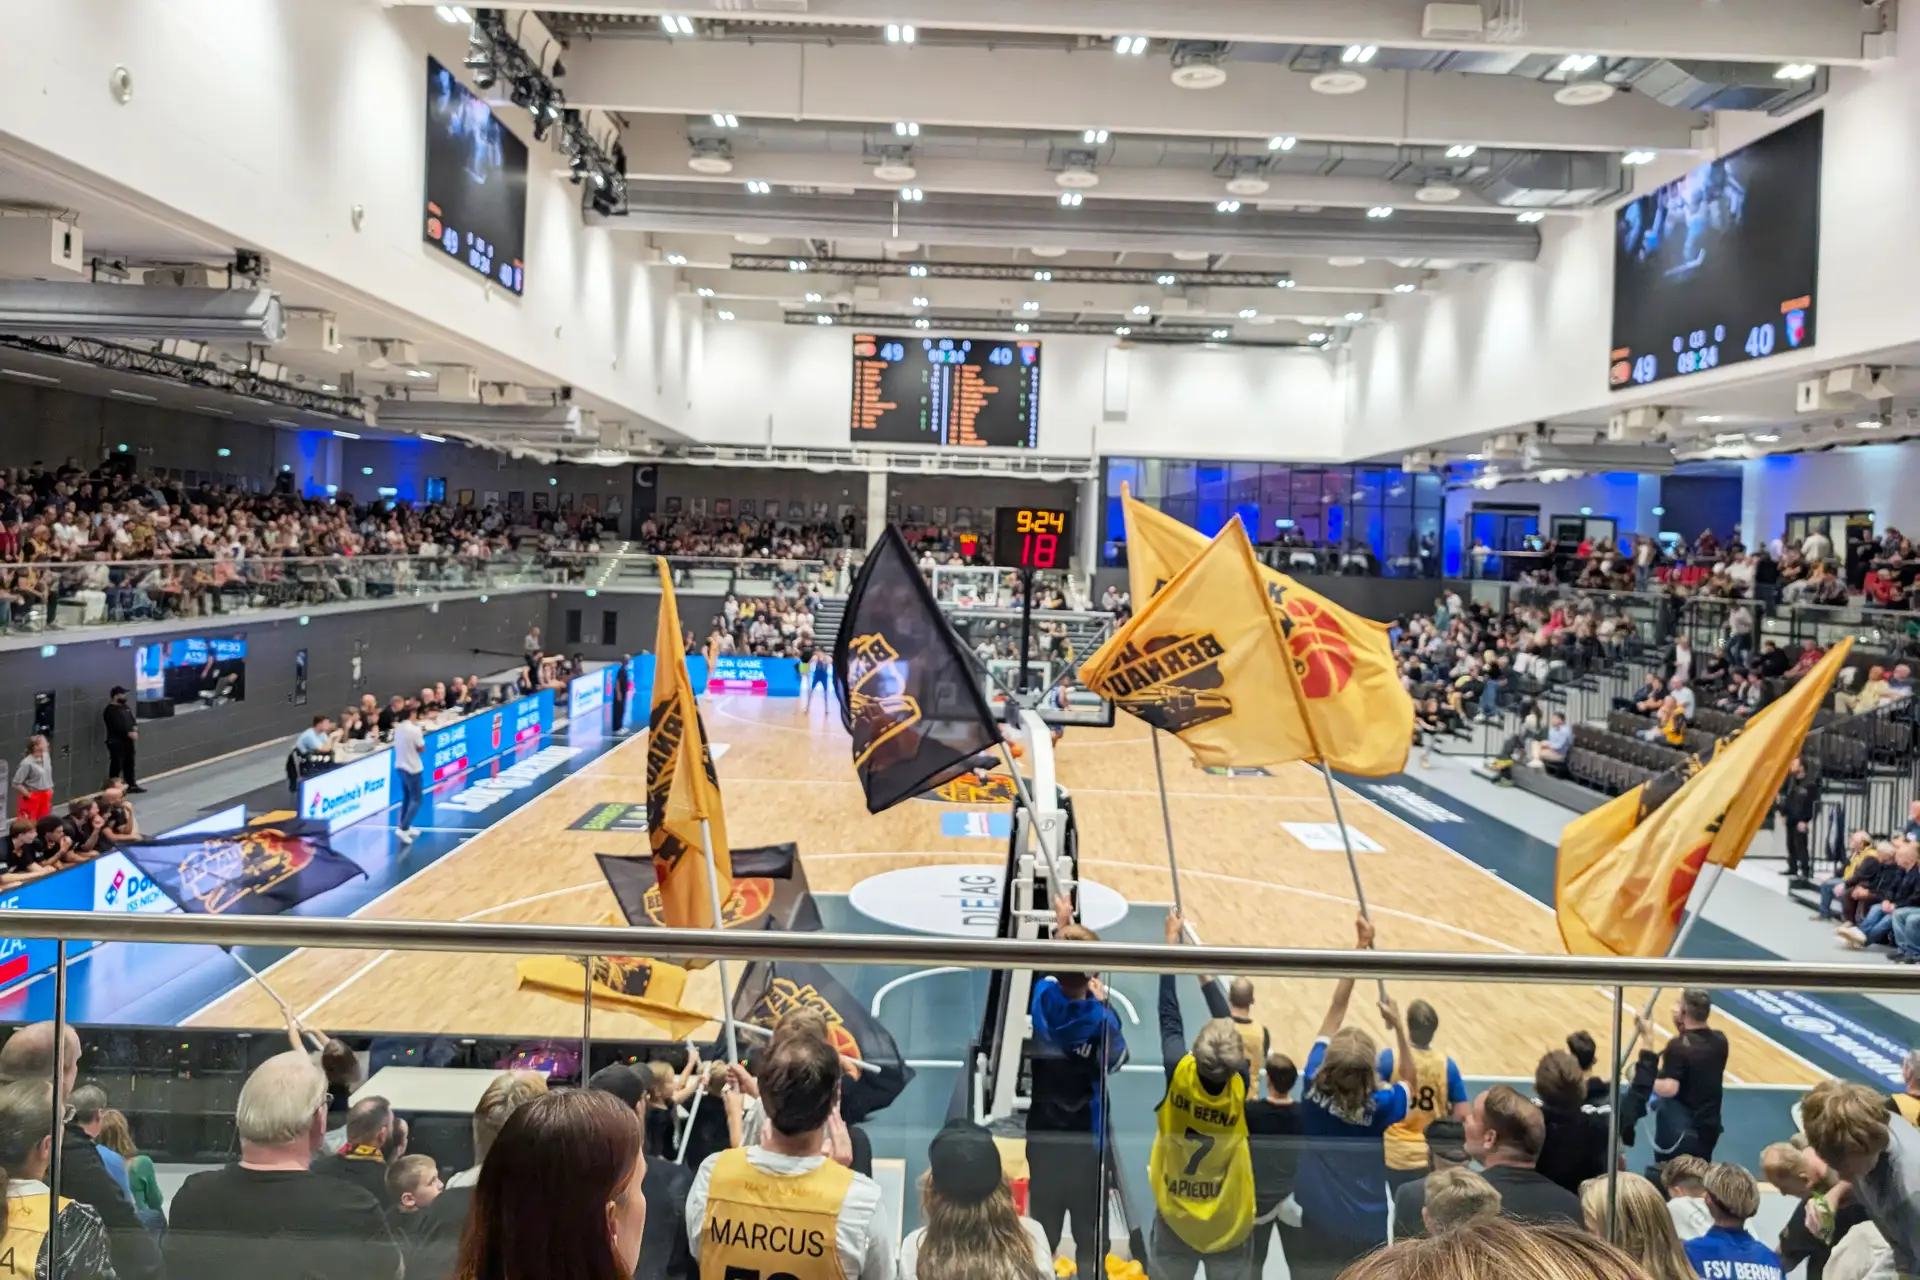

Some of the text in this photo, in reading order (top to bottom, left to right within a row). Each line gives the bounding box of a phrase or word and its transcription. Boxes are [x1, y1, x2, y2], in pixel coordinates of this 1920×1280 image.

[988, 346, 1013, 366] 40
[1744, 322, 1775, 357] 40
[1632, 354, 1657, 384] 49
[1021, 533, 1058, 568] 18
[1183, 1126, 1216, 1176] 7
[710, 1216, 825, 1258] MARCUS
[1702, 1259, 1732, 1280] FSV
